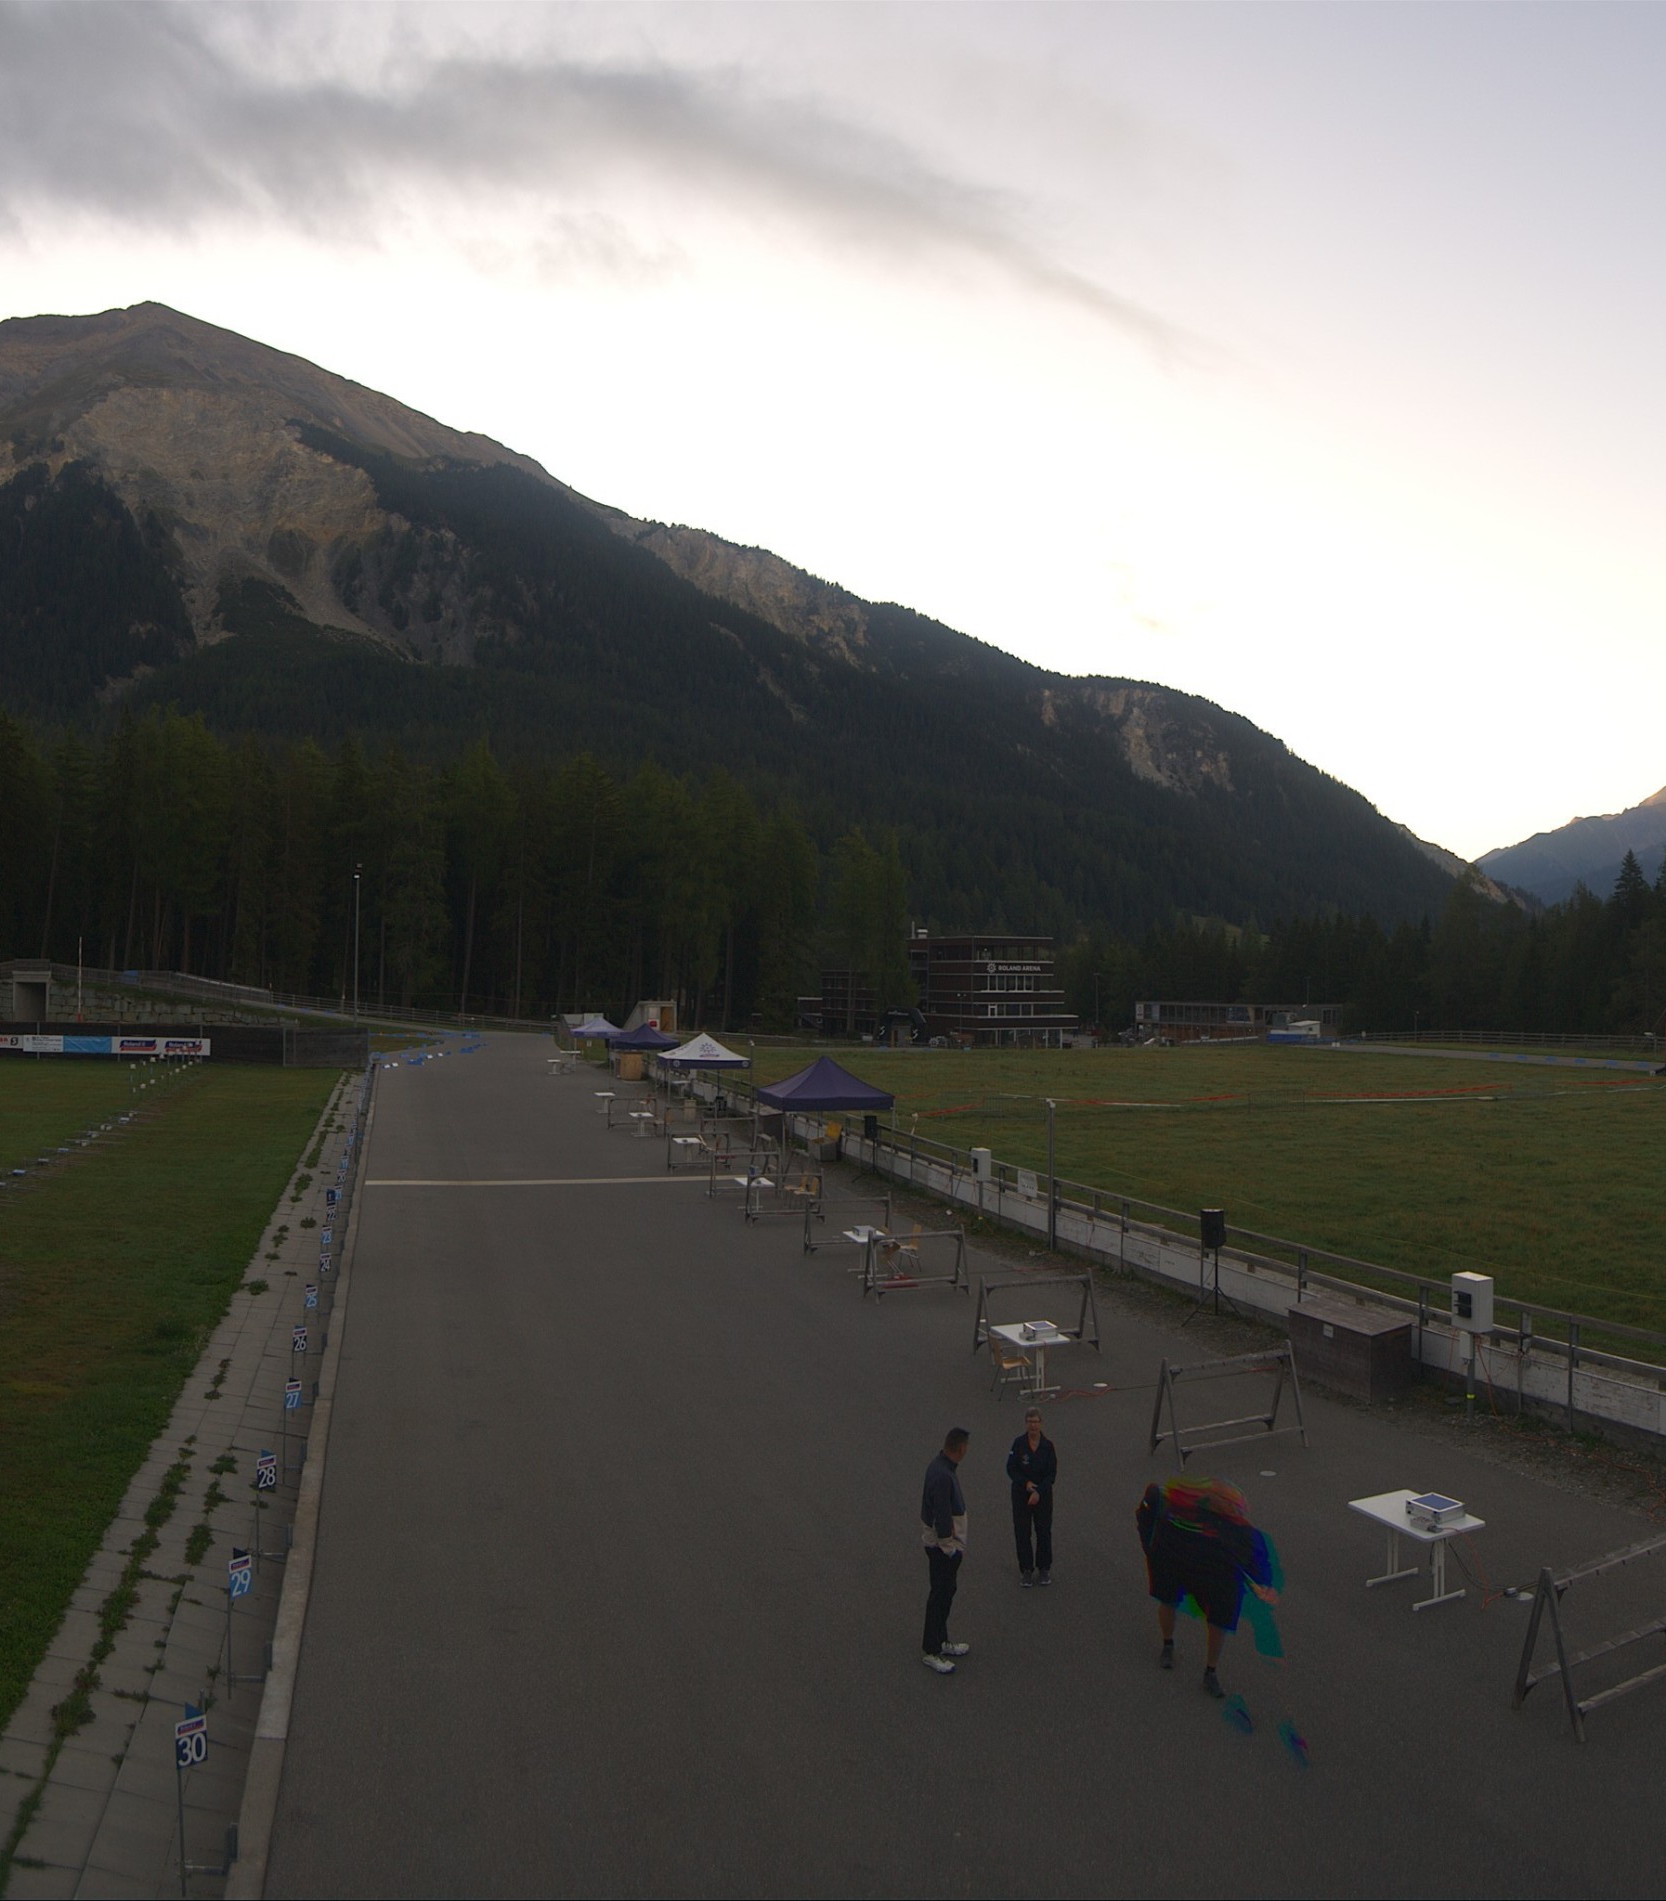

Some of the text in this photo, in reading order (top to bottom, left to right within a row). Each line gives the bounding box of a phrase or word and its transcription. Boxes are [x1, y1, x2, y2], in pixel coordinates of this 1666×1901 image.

[323, 1233, 332, 1244] 23
[321, 1260, 330, 1271] 24
[306, 1295, 317, 1307] 25
[294, 1337, 306, 1351] 26
[286, 1392, 299, 1408] 27
[258, 1467, 275, 1488] 28
[231, 1570, 251, 1597] 29
[178, 1733, 206, 1767] 30
